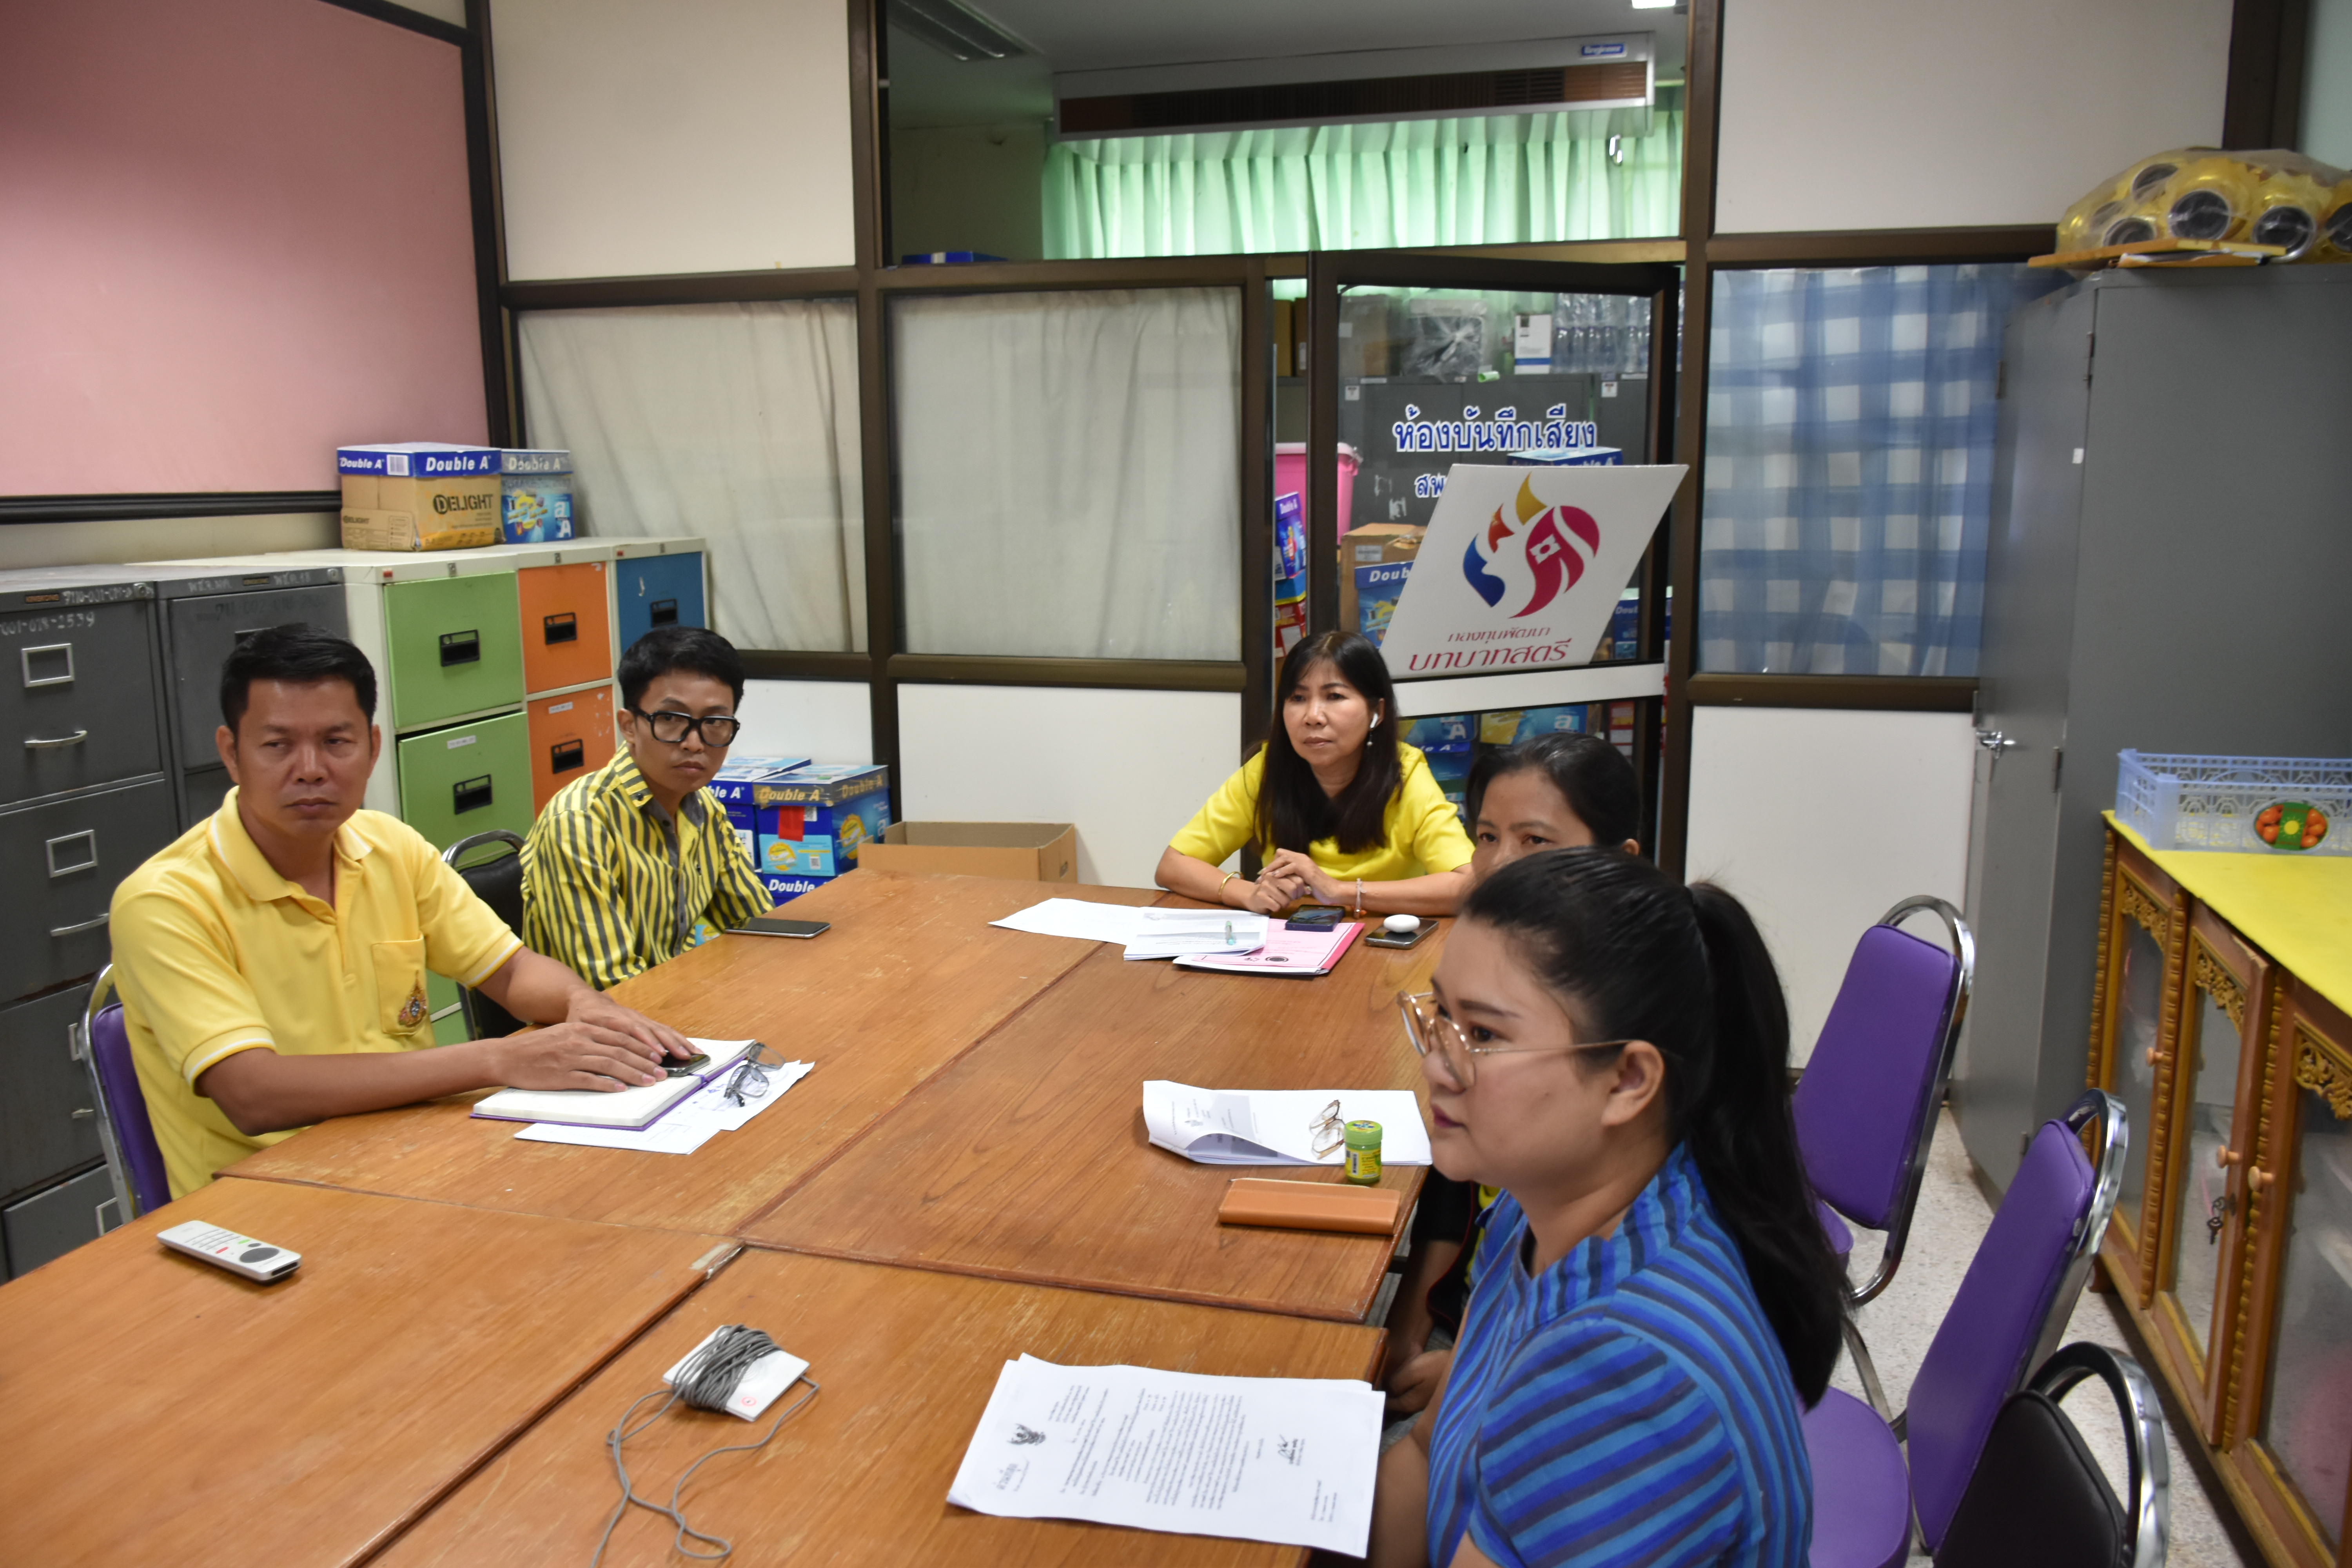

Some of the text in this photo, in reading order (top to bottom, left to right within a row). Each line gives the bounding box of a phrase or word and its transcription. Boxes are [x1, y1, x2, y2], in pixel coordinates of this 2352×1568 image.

[1392, 403, 1597, 452] ห้องบันทึกเสียง
[340, 457, 372, 468] Double
[426, 456, 488, 471] Double A
[433, 494, 493, 515] DELIGHT
[1409, 637, 1572, 671] บทบาทสตรี
[730, 787, 741, 799] A
[759, 787, 820, 801] Double A
[769, 879, 815, 893] Double
